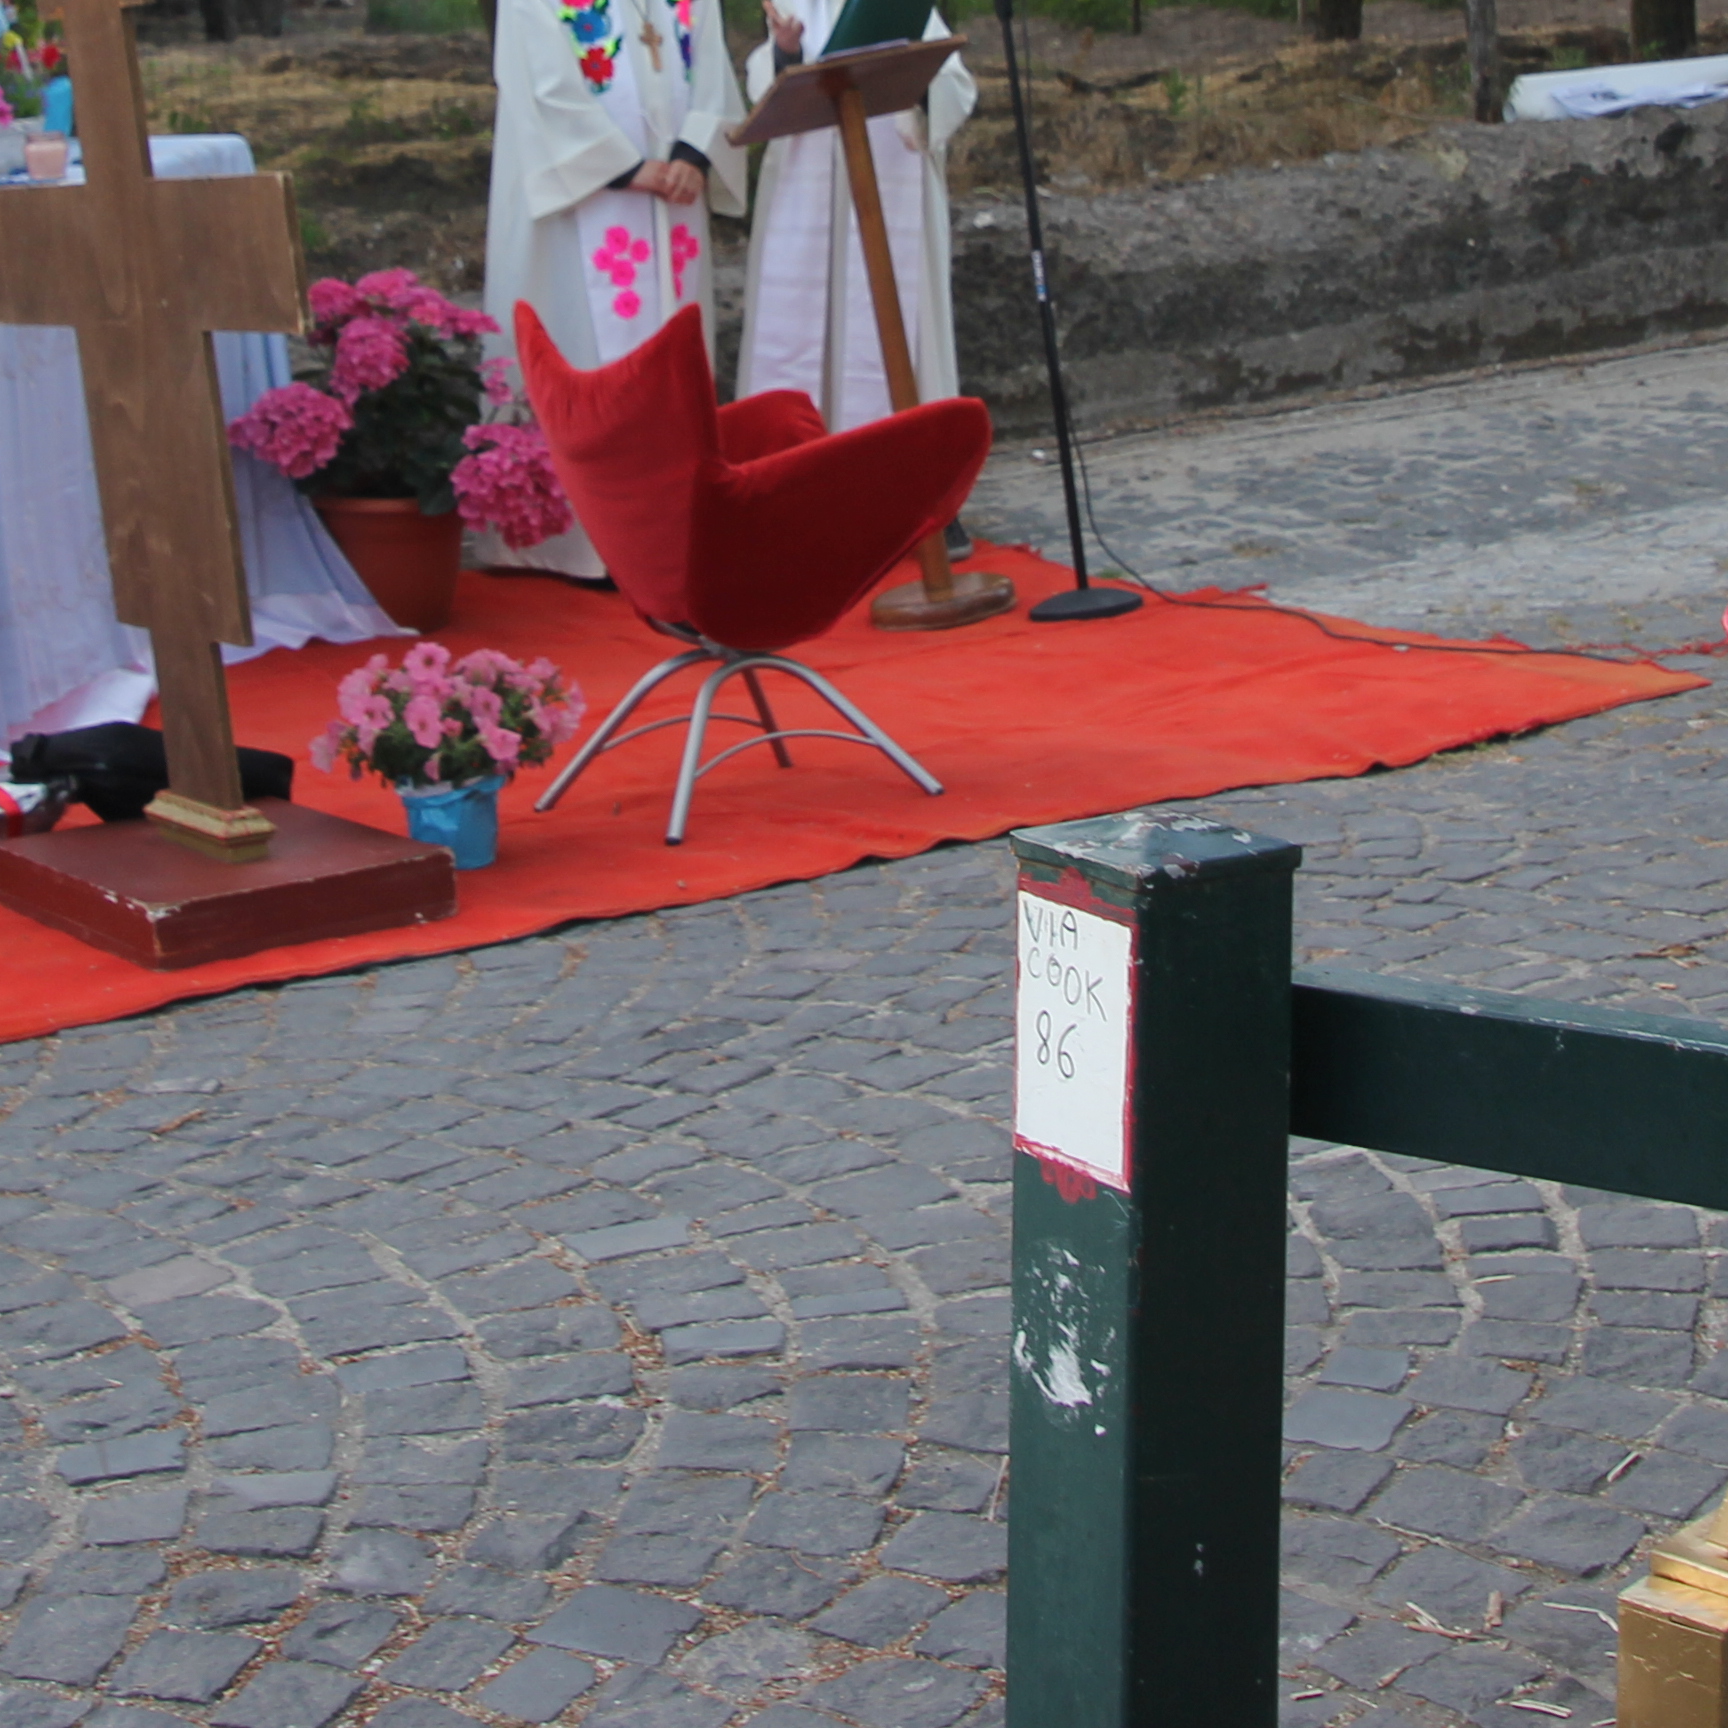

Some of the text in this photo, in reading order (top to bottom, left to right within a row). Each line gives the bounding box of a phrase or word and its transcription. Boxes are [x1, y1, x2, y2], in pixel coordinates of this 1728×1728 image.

[1023, 899, 1078, 950] VIA
[1027, 946, 1108, 1022] COOK
[1036, 1010, 1078, 1078] 86
